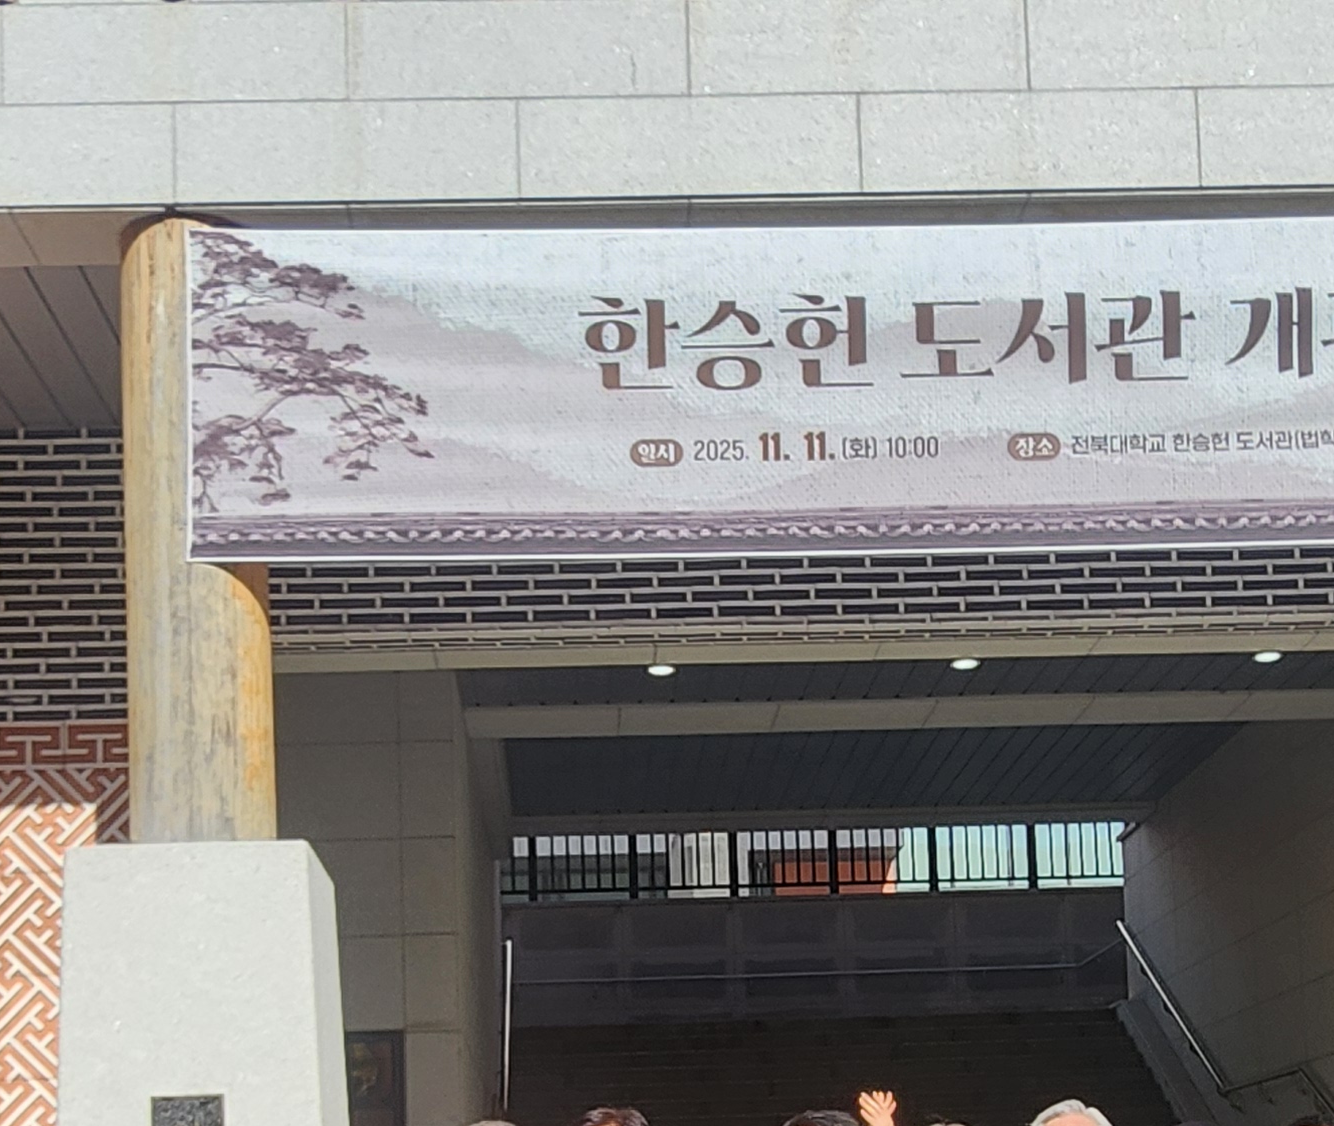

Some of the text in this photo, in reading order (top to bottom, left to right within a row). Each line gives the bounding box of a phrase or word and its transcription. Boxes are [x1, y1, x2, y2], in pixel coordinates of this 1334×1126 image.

[577, 293, 874, 391] 한승헌
[900, 289, 1197, 385] 도서관
[692, 439, 749, 461] 2025.
[758, 431, 791, 462] 11.
[803, 430, 836, 462] 11.
[841, 435, 878, 460] (화)
[886, 435, 940, 459] 10:00
[1014, 436, 1056, 458] 장소
[1070, 433, 1167, 455] 전북대학교
[1172, 431, 1230, 453] 한승헌
